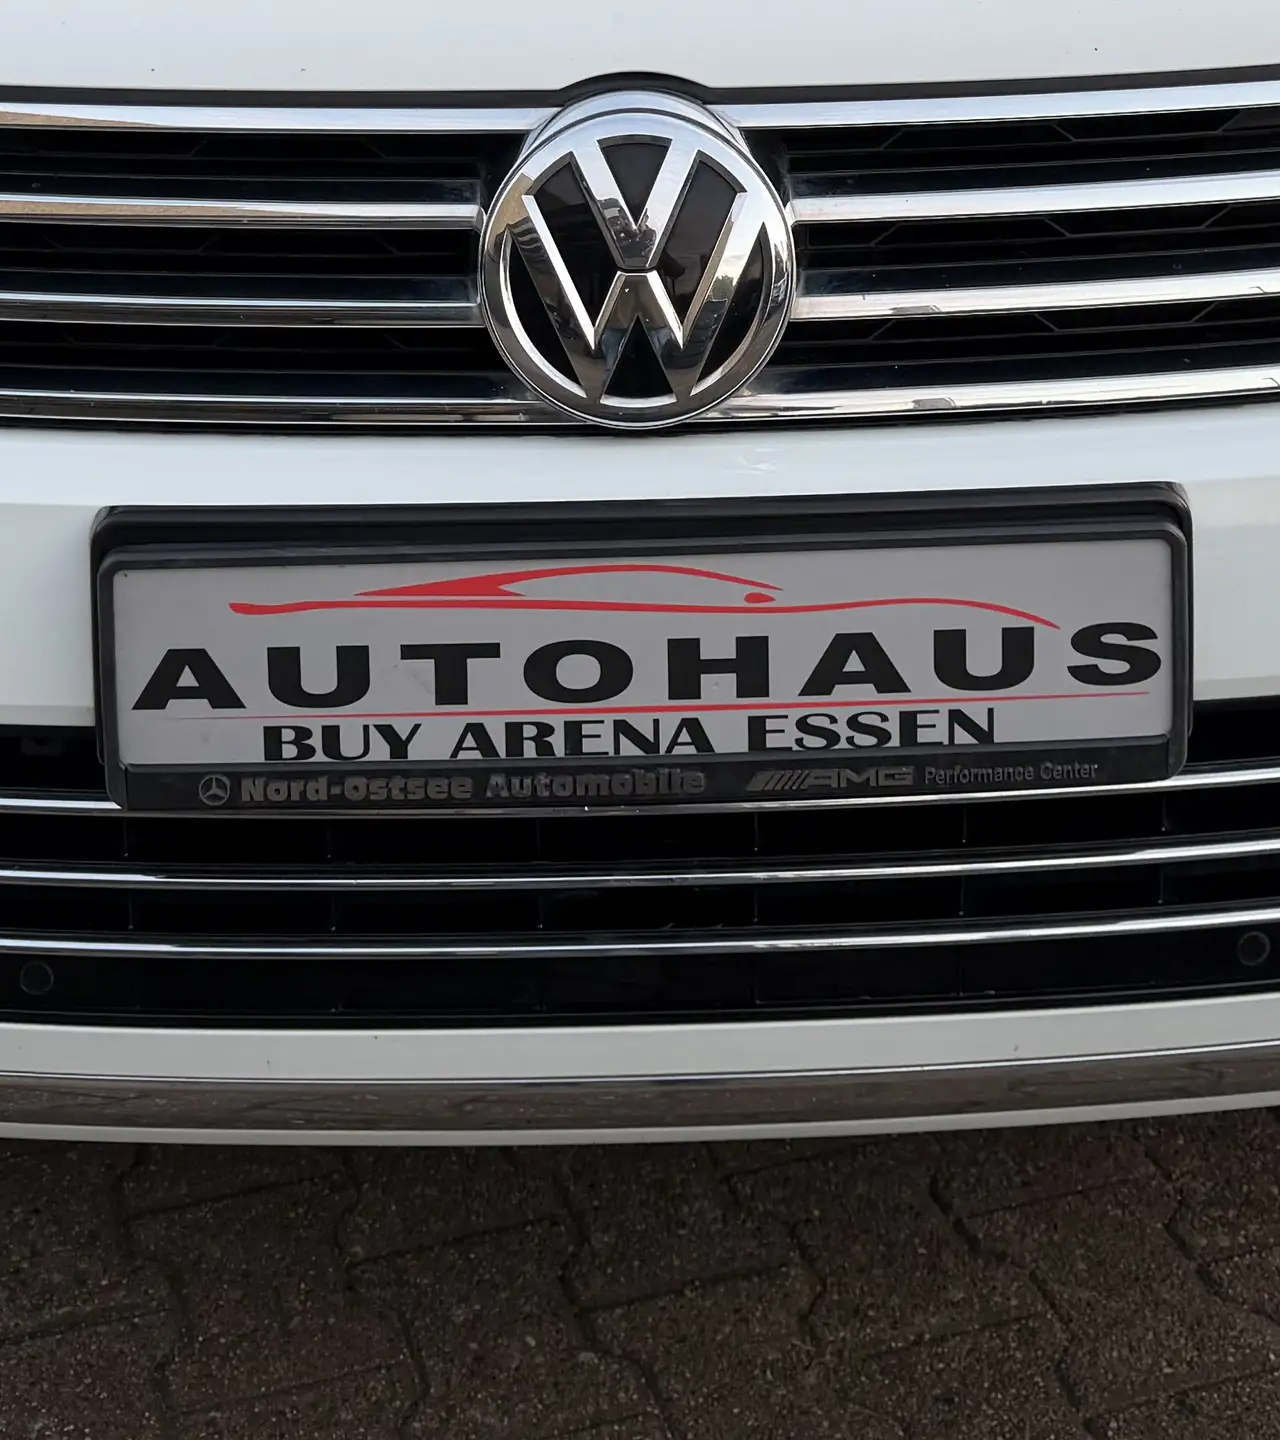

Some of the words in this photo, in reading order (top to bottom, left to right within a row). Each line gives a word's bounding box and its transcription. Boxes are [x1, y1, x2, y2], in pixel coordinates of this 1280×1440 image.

[131, 621, 1163, 712] AUTOHAUS
[262, 723, 424, 763] BUY
[449, 717, 718, 759] ARENA
[744, 707, 996, 753] ESSEN
[240, 774, 473, 803] Nord-Ostsee
[485, 769, 706, 799] Automobile
[806, 765, 915, 790] AMG
[924, 764, 1034, 786] Performance
[1040, 762, 1098, 781] Center
